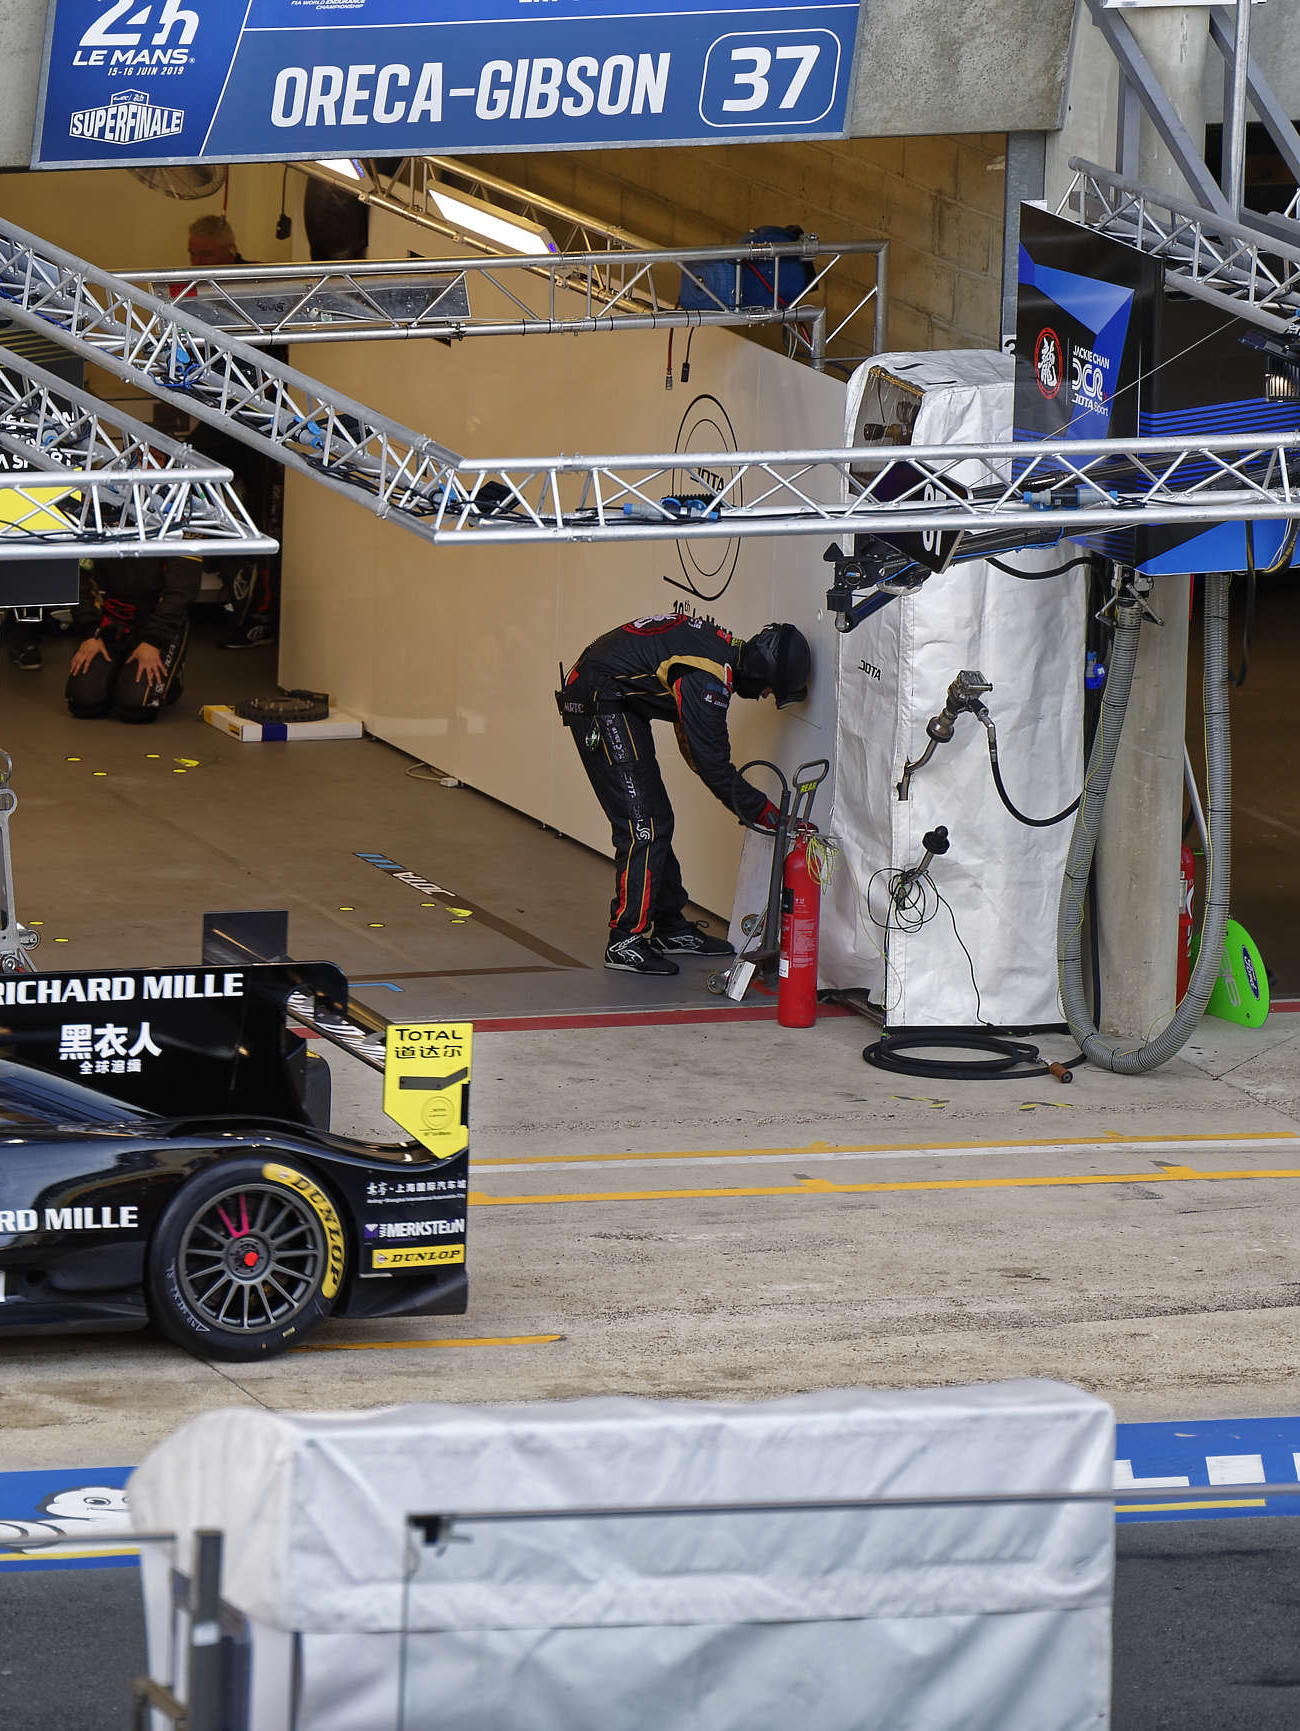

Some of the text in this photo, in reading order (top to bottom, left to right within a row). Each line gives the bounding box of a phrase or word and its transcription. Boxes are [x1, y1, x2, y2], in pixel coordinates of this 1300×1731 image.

[315, 2, 364, 10] CHAMPIONSHIP
[78, 0, 200, 46] 24h
[73, 48, 189, 67] LE MANS
[108, 66, 185, 77] 15-16 JUIN 2019
[721, 45, 821, 112] 37
[270, 52, 671, 128] ORECA-GIBSON
[71, 104, 183, 142] SUPERFINALE
[1092, 351, 1111, 370] CHAN
[1071, 392, 1094, 411] JOTA
[143, 972, 244, 1000] MILLE
[58, 1021, 163, 1061] 黑衣人
[394, 1028, 464, 1042] TOTAL
[394, 1045, 463, 1059] 道达尔
[45, 1205, 139, 1232] MILLE
[291, 1175, 345, 1287] DUNLOP
[390, 1250, 461, 1264] DUNLOP
